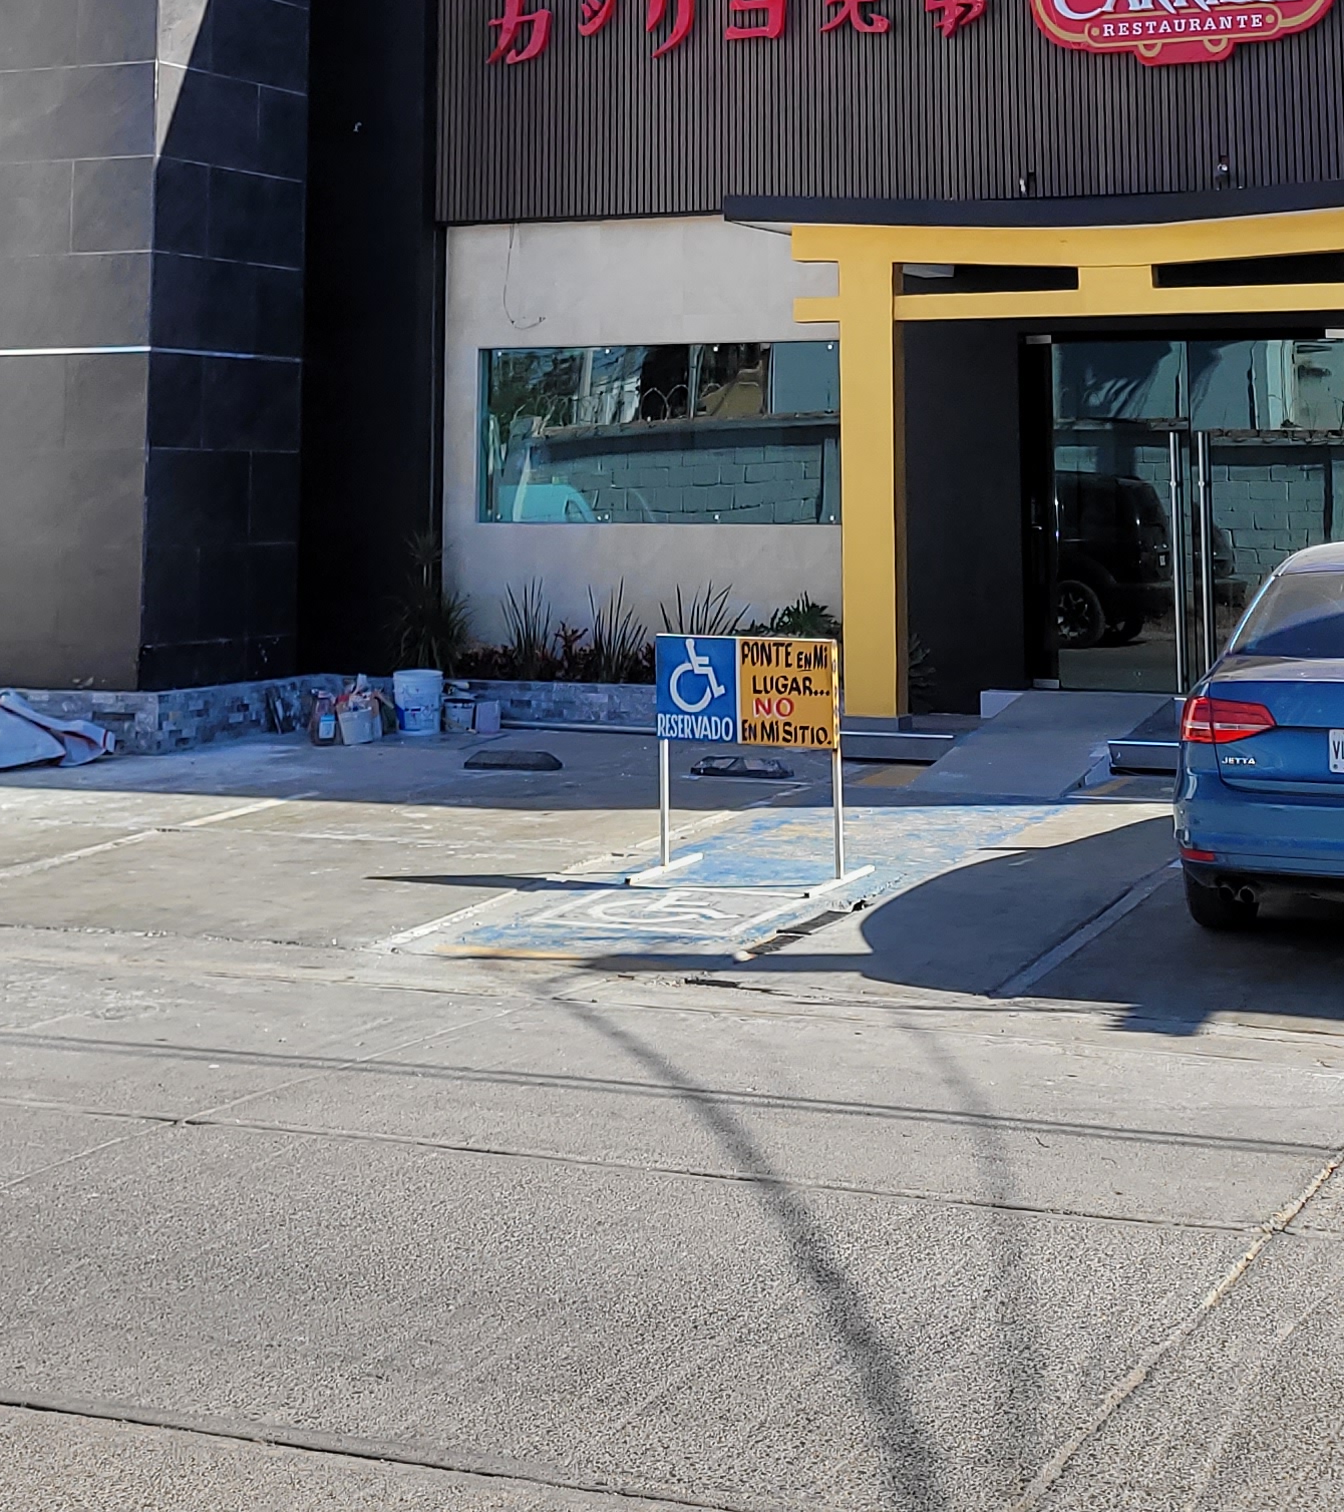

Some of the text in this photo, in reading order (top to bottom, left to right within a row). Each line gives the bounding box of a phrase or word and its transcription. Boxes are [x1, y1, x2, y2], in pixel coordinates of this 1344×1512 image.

[1102, 14, 1264, 38] RESTAURANTE
[741, 641, 793, 668] PONTE
[753, 697, 795, 719] NO
[657, 713, 734, 742] RESERVADO
[782, 721, 832, 745] SITIO.
[1221, 756, 1256, 765] JETTA
